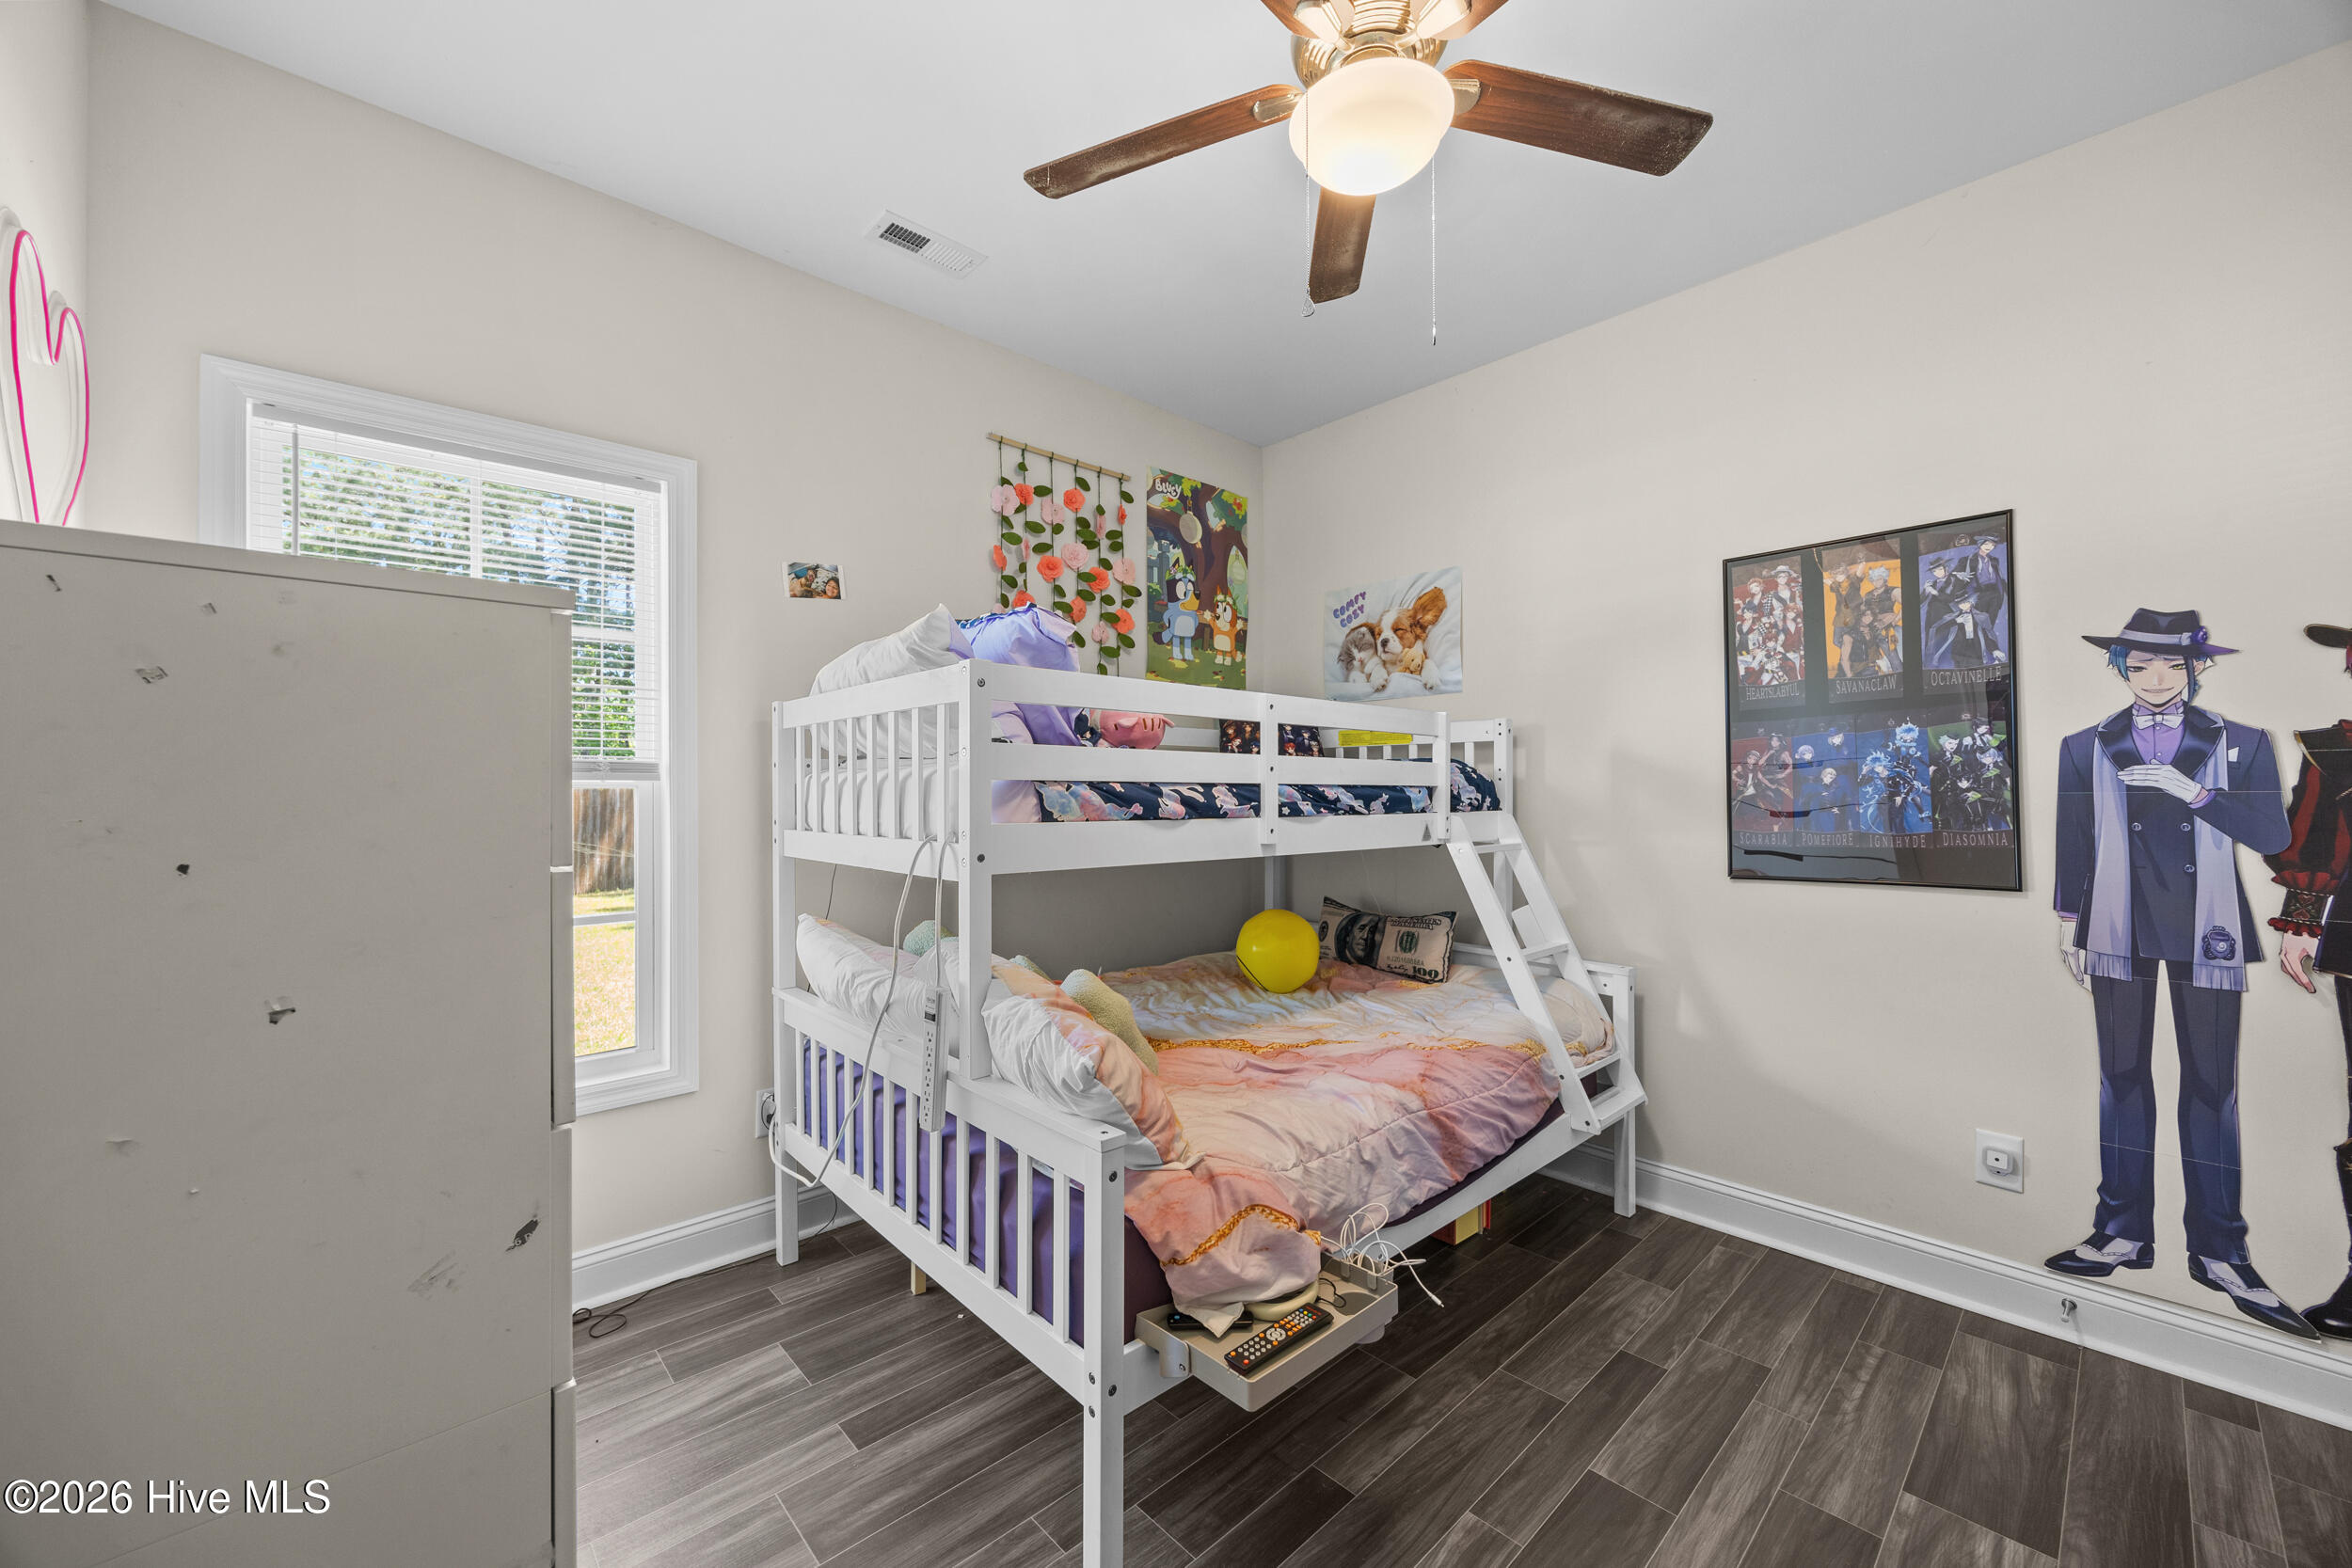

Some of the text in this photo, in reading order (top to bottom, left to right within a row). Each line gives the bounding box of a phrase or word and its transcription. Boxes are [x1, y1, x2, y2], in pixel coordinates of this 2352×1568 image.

[1333, 591, 1366, 619] COMFY
[1340, 604, 1365, 628] COZY
[1836, 674, 1897, 694] SAVANACLAW
[1931, 666, 2002, 686] OCTAVINELLE
[1745, 683, 1800, 701] HEARTSLABYUL
[1740, 832, 1788, 846] SCARABIA
[1802, 832, 1853, 846] POMEFIORE
[1869, 833, 1927, 848] IGNIHYDE
[1943, 832, 2009, 847] DIASOMNIA
[1412, 965, 1439, 979] 100
